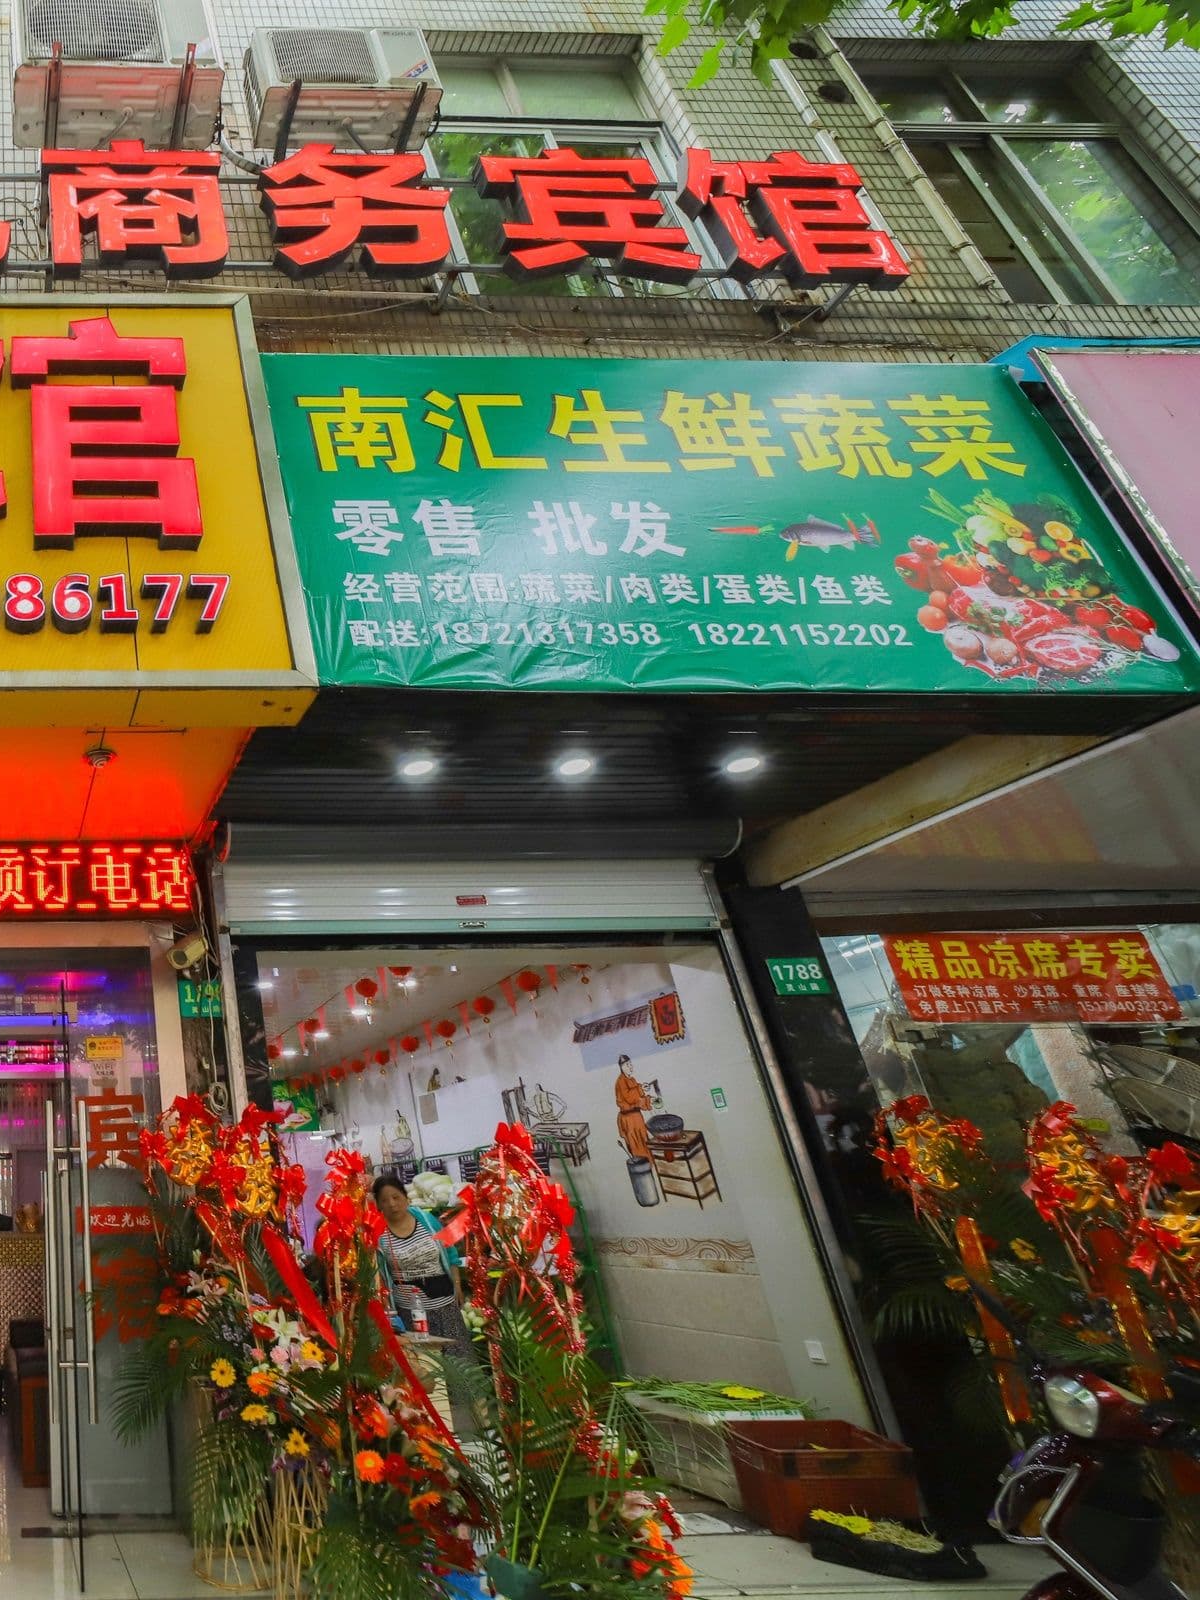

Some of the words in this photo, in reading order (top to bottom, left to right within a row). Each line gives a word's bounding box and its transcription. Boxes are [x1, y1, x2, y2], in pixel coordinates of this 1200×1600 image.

[297, 385, 1027, 480] 南汇生鲜蔬菜
[332, 499, 483, 557] 零售
[527, 499, 686, 557] 批发
[687, 623, 913, 646] 18221152202
[773, 964, 822, 980] 1788
